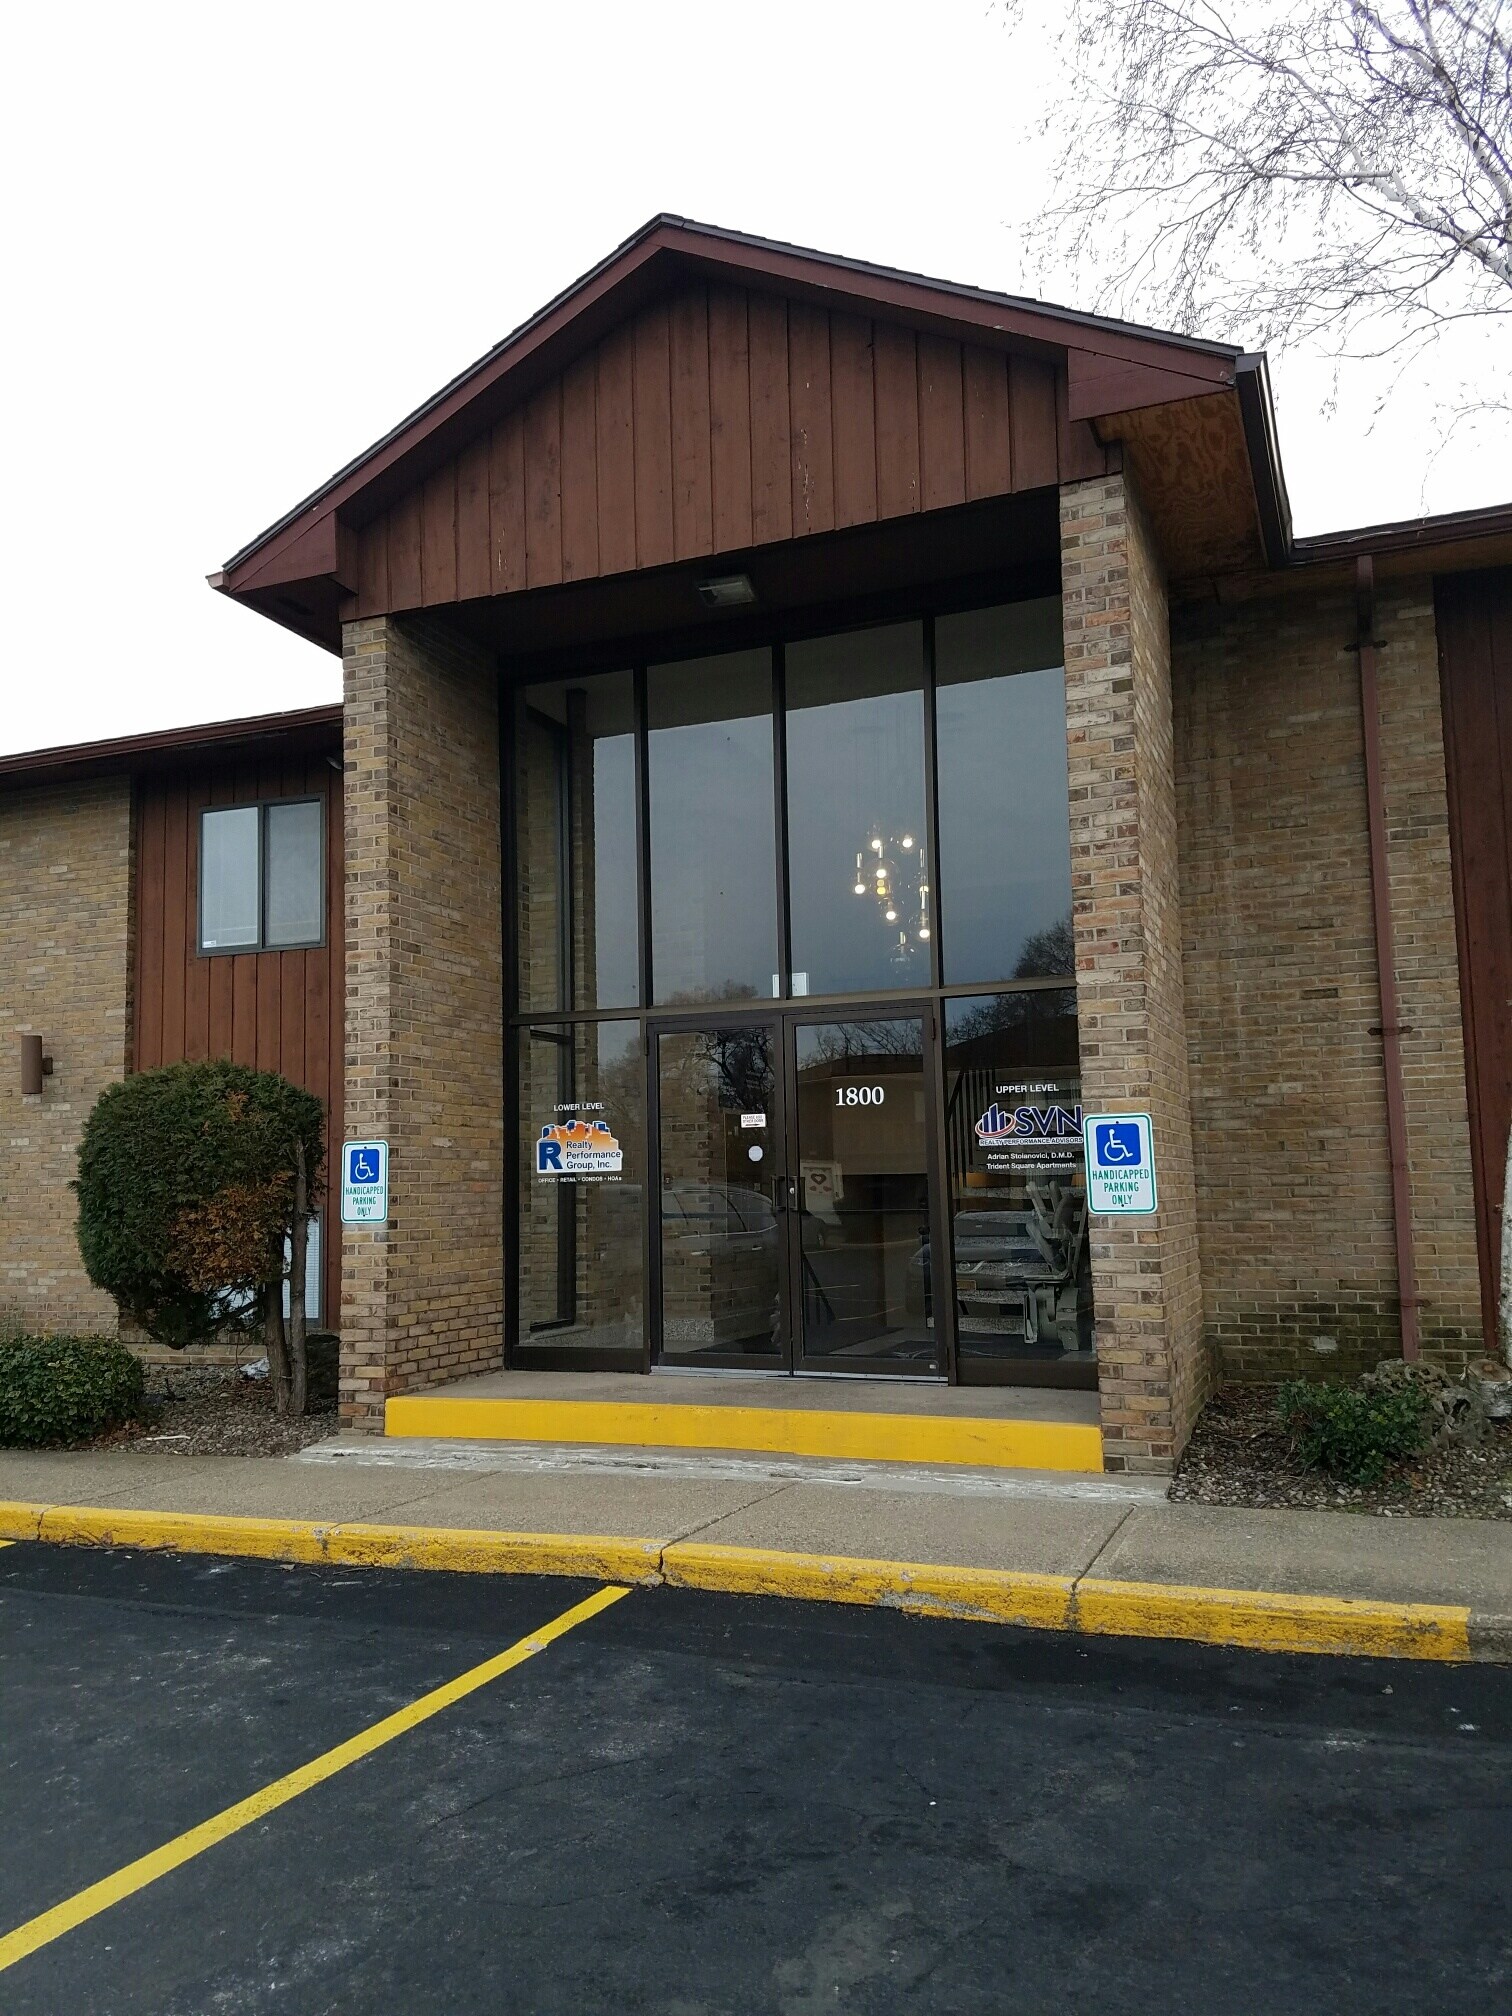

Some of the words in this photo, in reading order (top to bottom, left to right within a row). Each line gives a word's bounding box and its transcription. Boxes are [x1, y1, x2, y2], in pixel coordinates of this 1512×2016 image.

[1030, 1084, 1060, 1092] LEVEL
[835, 1086, 884, 1106] 1800
[554, 1104, 580, 1112] LOWER
[1014, 1104, 1084, 1136] SVN
[566, 1140, 592, 1150] Realty
[538, 1142, 563, 1170] R
[566, 1150, 620, 1160] Performance
[566, 1161, 594, 1170] Group,
[1092, 1169, 1150, 1180] HANDICAPPED
[346, 1186, 384, 1194] HANDICAPPED
[1104, 1182, 1139, 1192] PARKING
[352, 1197, 376, 1205] PARKING
[1112, 1194, 1132, 1204] ONLY
[357, 1207, 372, 1216] ONLY
